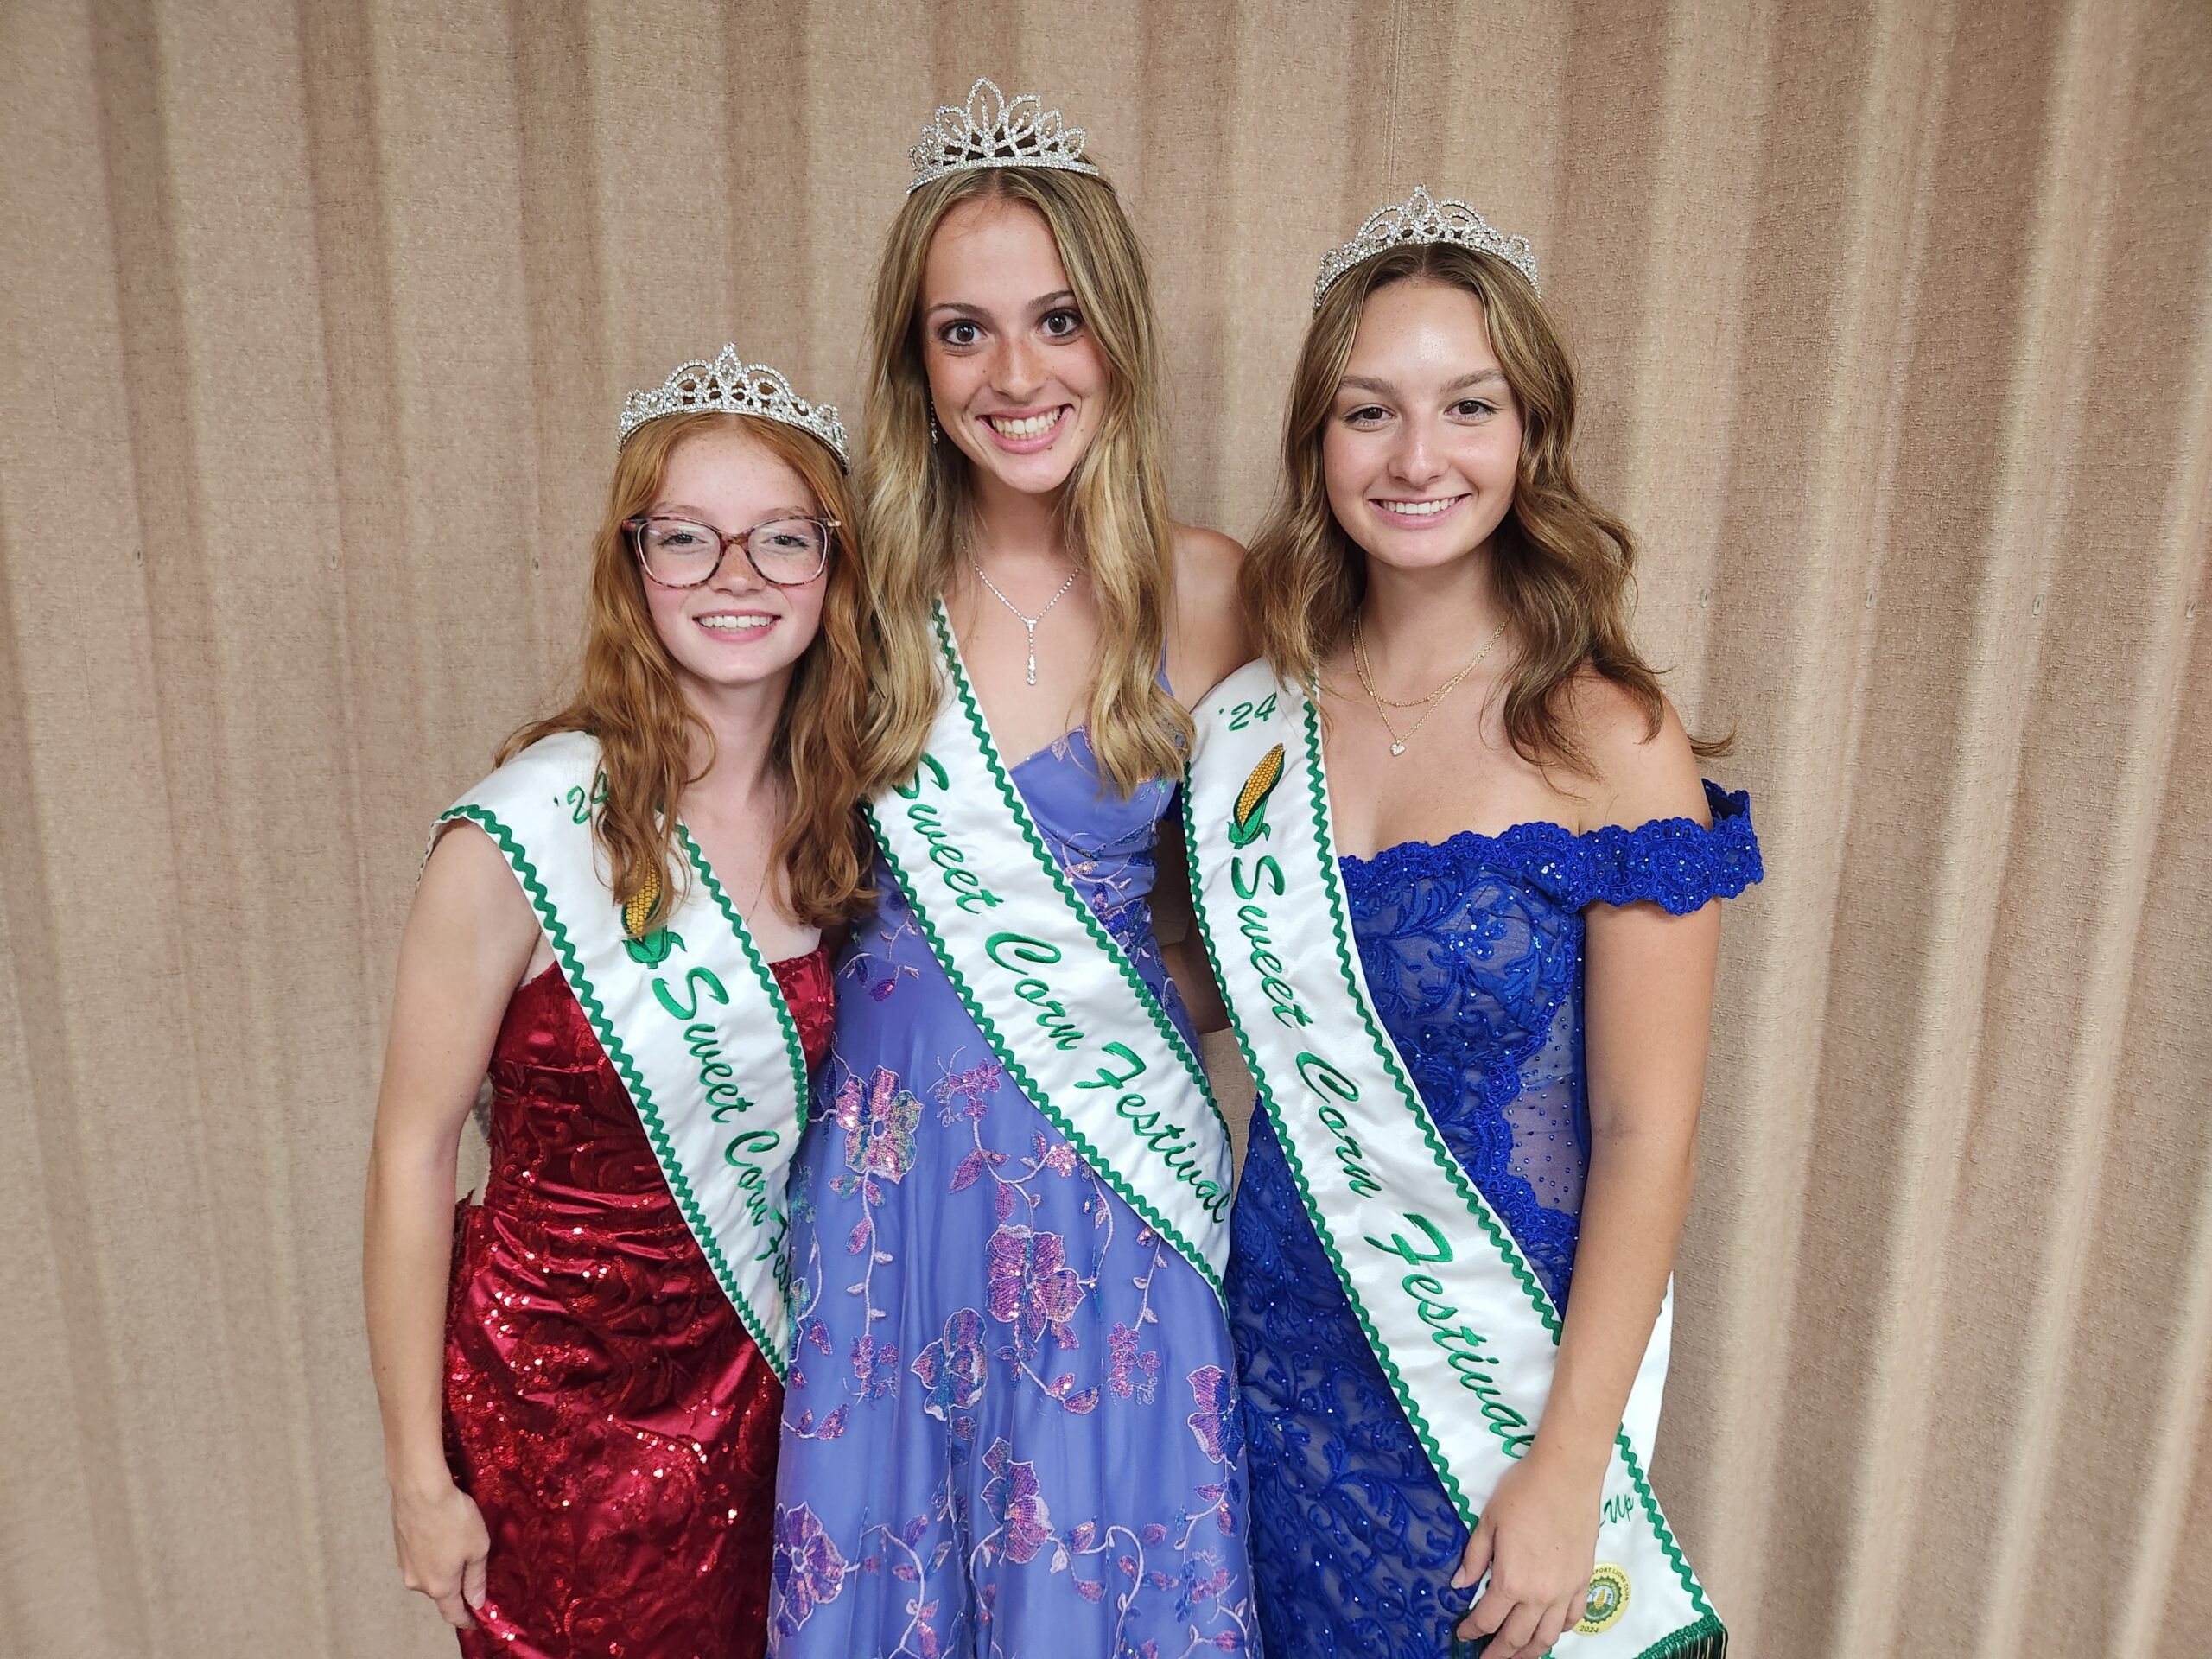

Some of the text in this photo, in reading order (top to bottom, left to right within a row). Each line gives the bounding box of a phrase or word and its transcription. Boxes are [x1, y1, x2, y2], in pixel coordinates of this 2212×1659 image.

[1217, 691, 1277, 731] '24
[653, 967, 753, 1123] Sweet
[725, 1130, 780, 1227] Corn
[892, 752, 1232, 1224] Sweet Corn Festival
[1230, 855, 1536, 1459] Sweet Corn Festival
